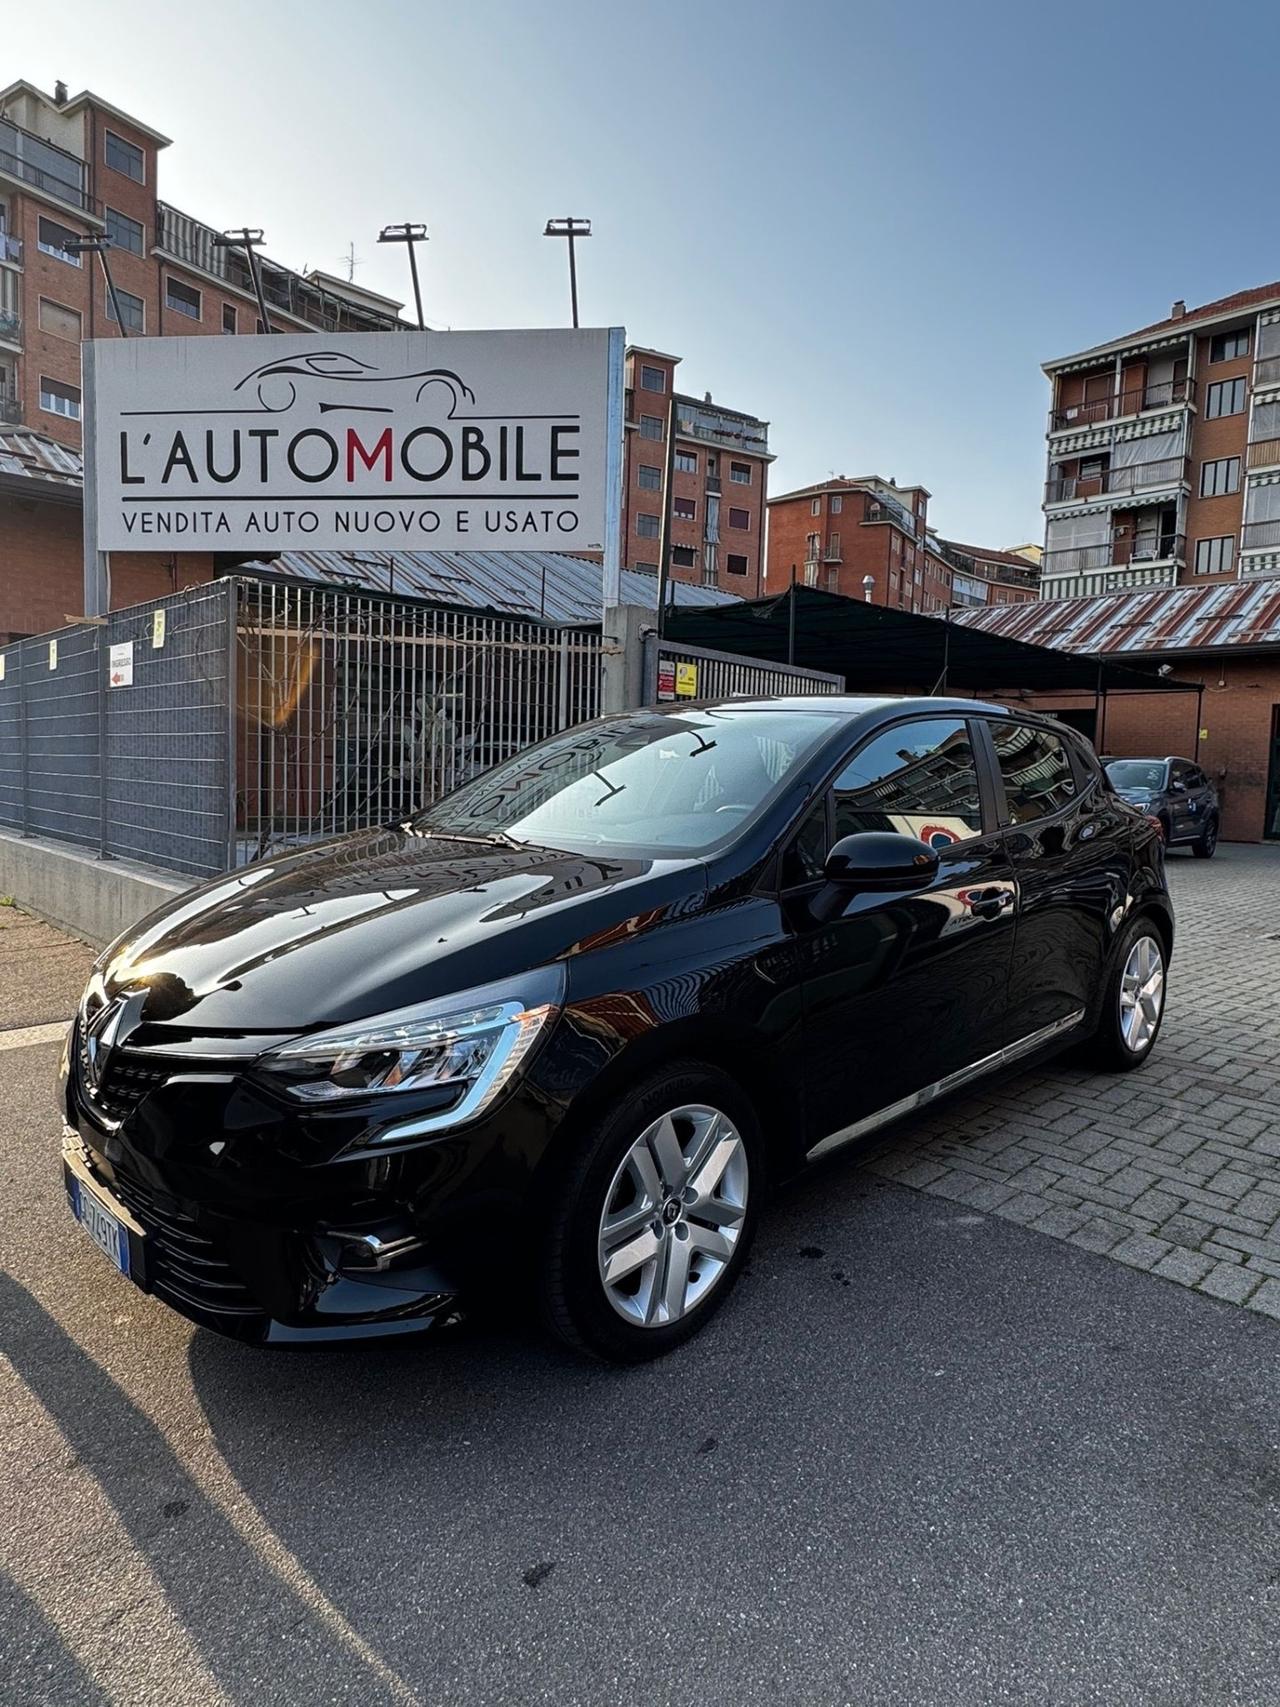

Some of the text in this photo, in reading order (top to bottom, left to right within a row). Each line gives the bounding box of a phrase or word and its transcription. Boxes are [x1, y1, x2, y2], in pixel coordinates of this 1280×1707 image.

[121, 425, 580, 484] L'AUTOMOBILE
[122, 510, 578, 533] VENDITA AUTO NUOVO E USATO
